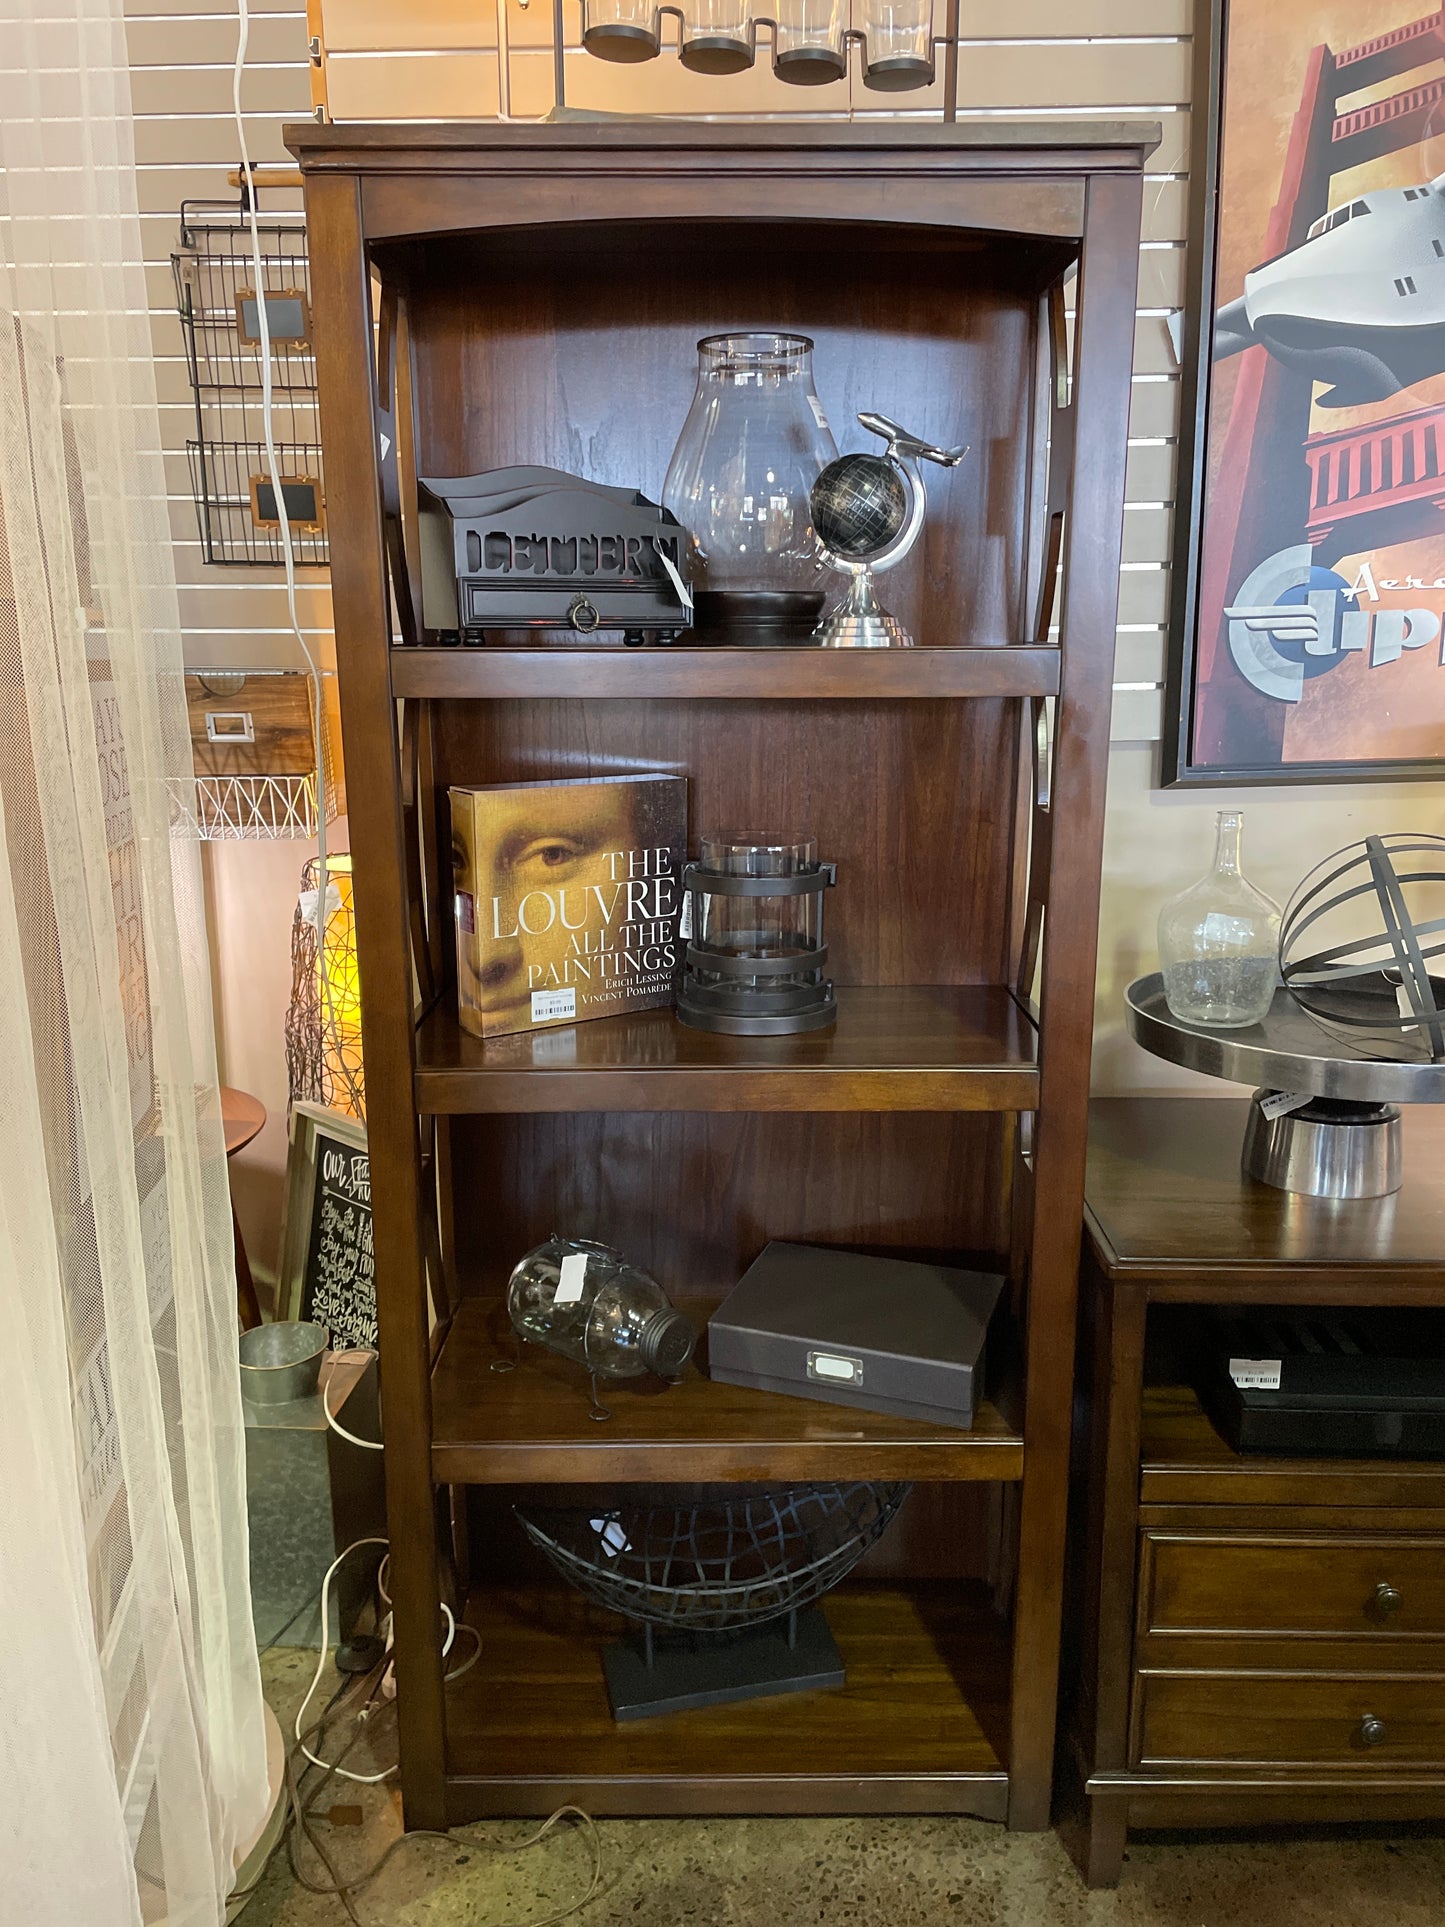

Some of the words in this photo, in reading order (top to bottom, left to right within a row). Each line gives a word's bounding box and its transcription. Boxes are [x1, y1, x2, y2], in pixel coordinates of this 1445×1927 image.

[602, 847, 672, 880] THE
[490, 877, 678, 939] LOUVRE
[564, 929, 614, 957] ALL
[619, 920, 673, 948] THE
[528, 944, 676, 988] PAINTINGS
